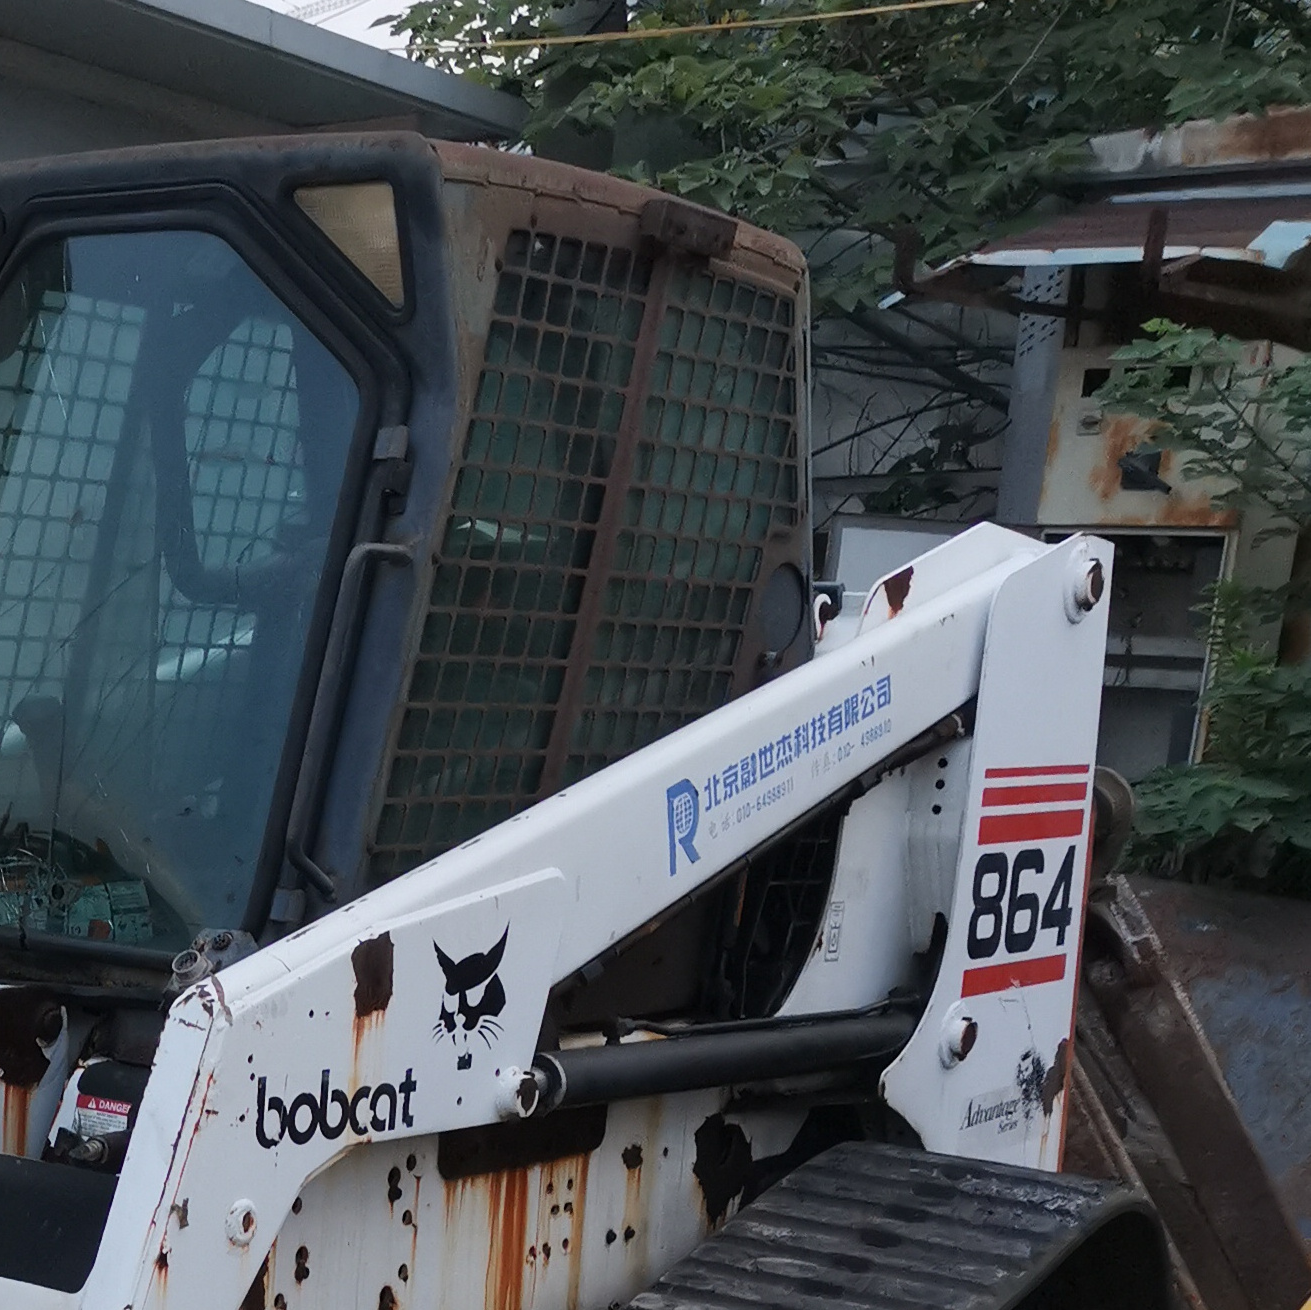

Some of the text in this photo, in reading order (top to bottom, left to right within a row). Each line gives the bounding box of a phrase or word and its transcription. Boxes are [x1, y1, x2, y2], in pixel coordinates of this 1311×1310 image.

[703, 674, 892, 813] 北京融世杰科技有限公司
[967, 845, 1077, 960] 864
[256, 1068, 417, 1149] bobcat
